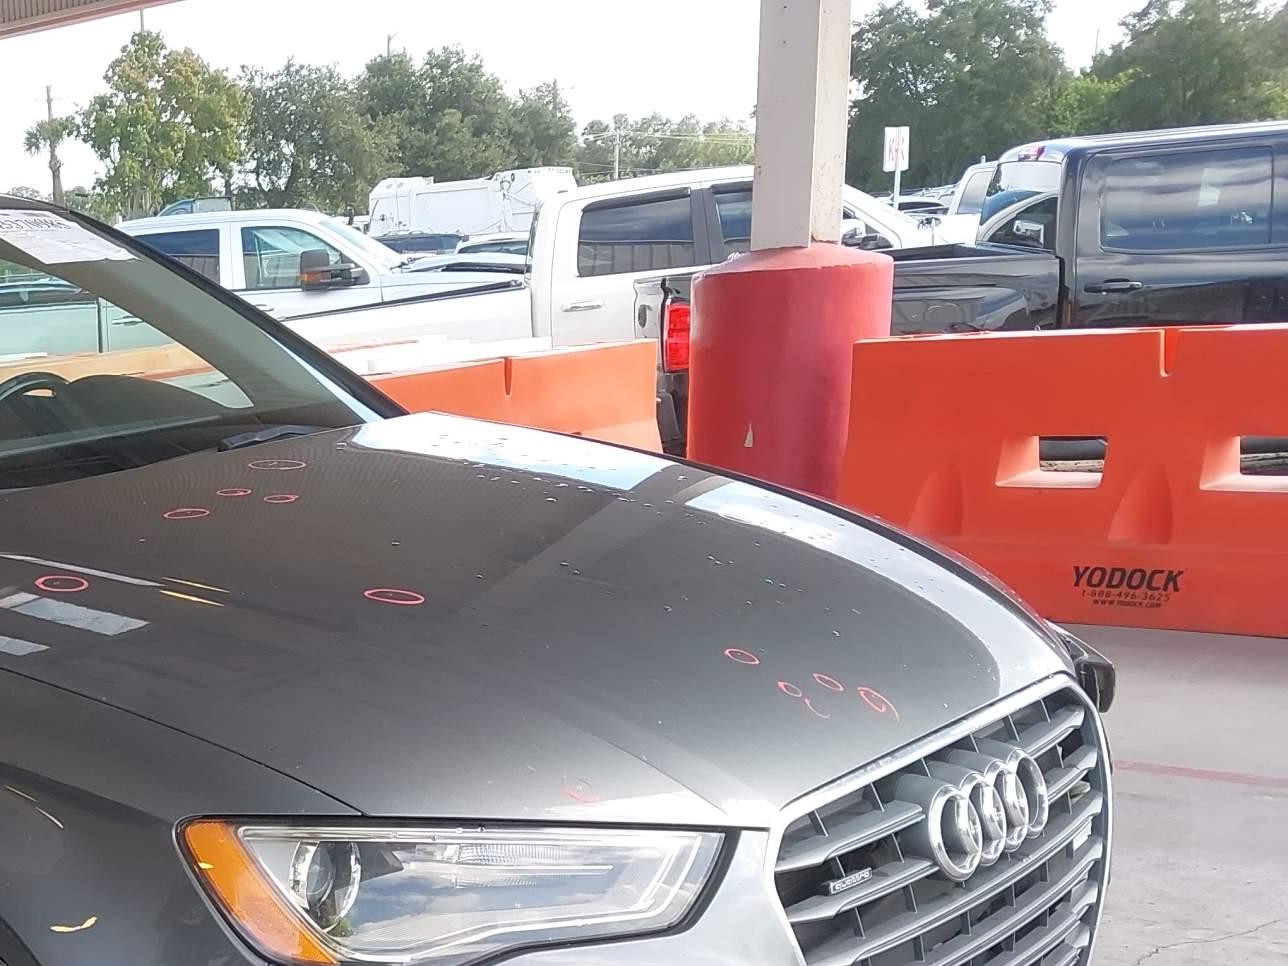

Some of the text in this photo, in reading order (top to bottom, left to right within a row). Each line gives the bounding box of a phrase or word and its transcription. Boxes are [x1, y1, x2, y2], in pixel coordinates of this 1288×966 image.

[1073, 566, 1184, 592] YODOCK
[1081, 589, 1171, 602] 1-888-496-3625
[835, 871, 870, 890] quattro
